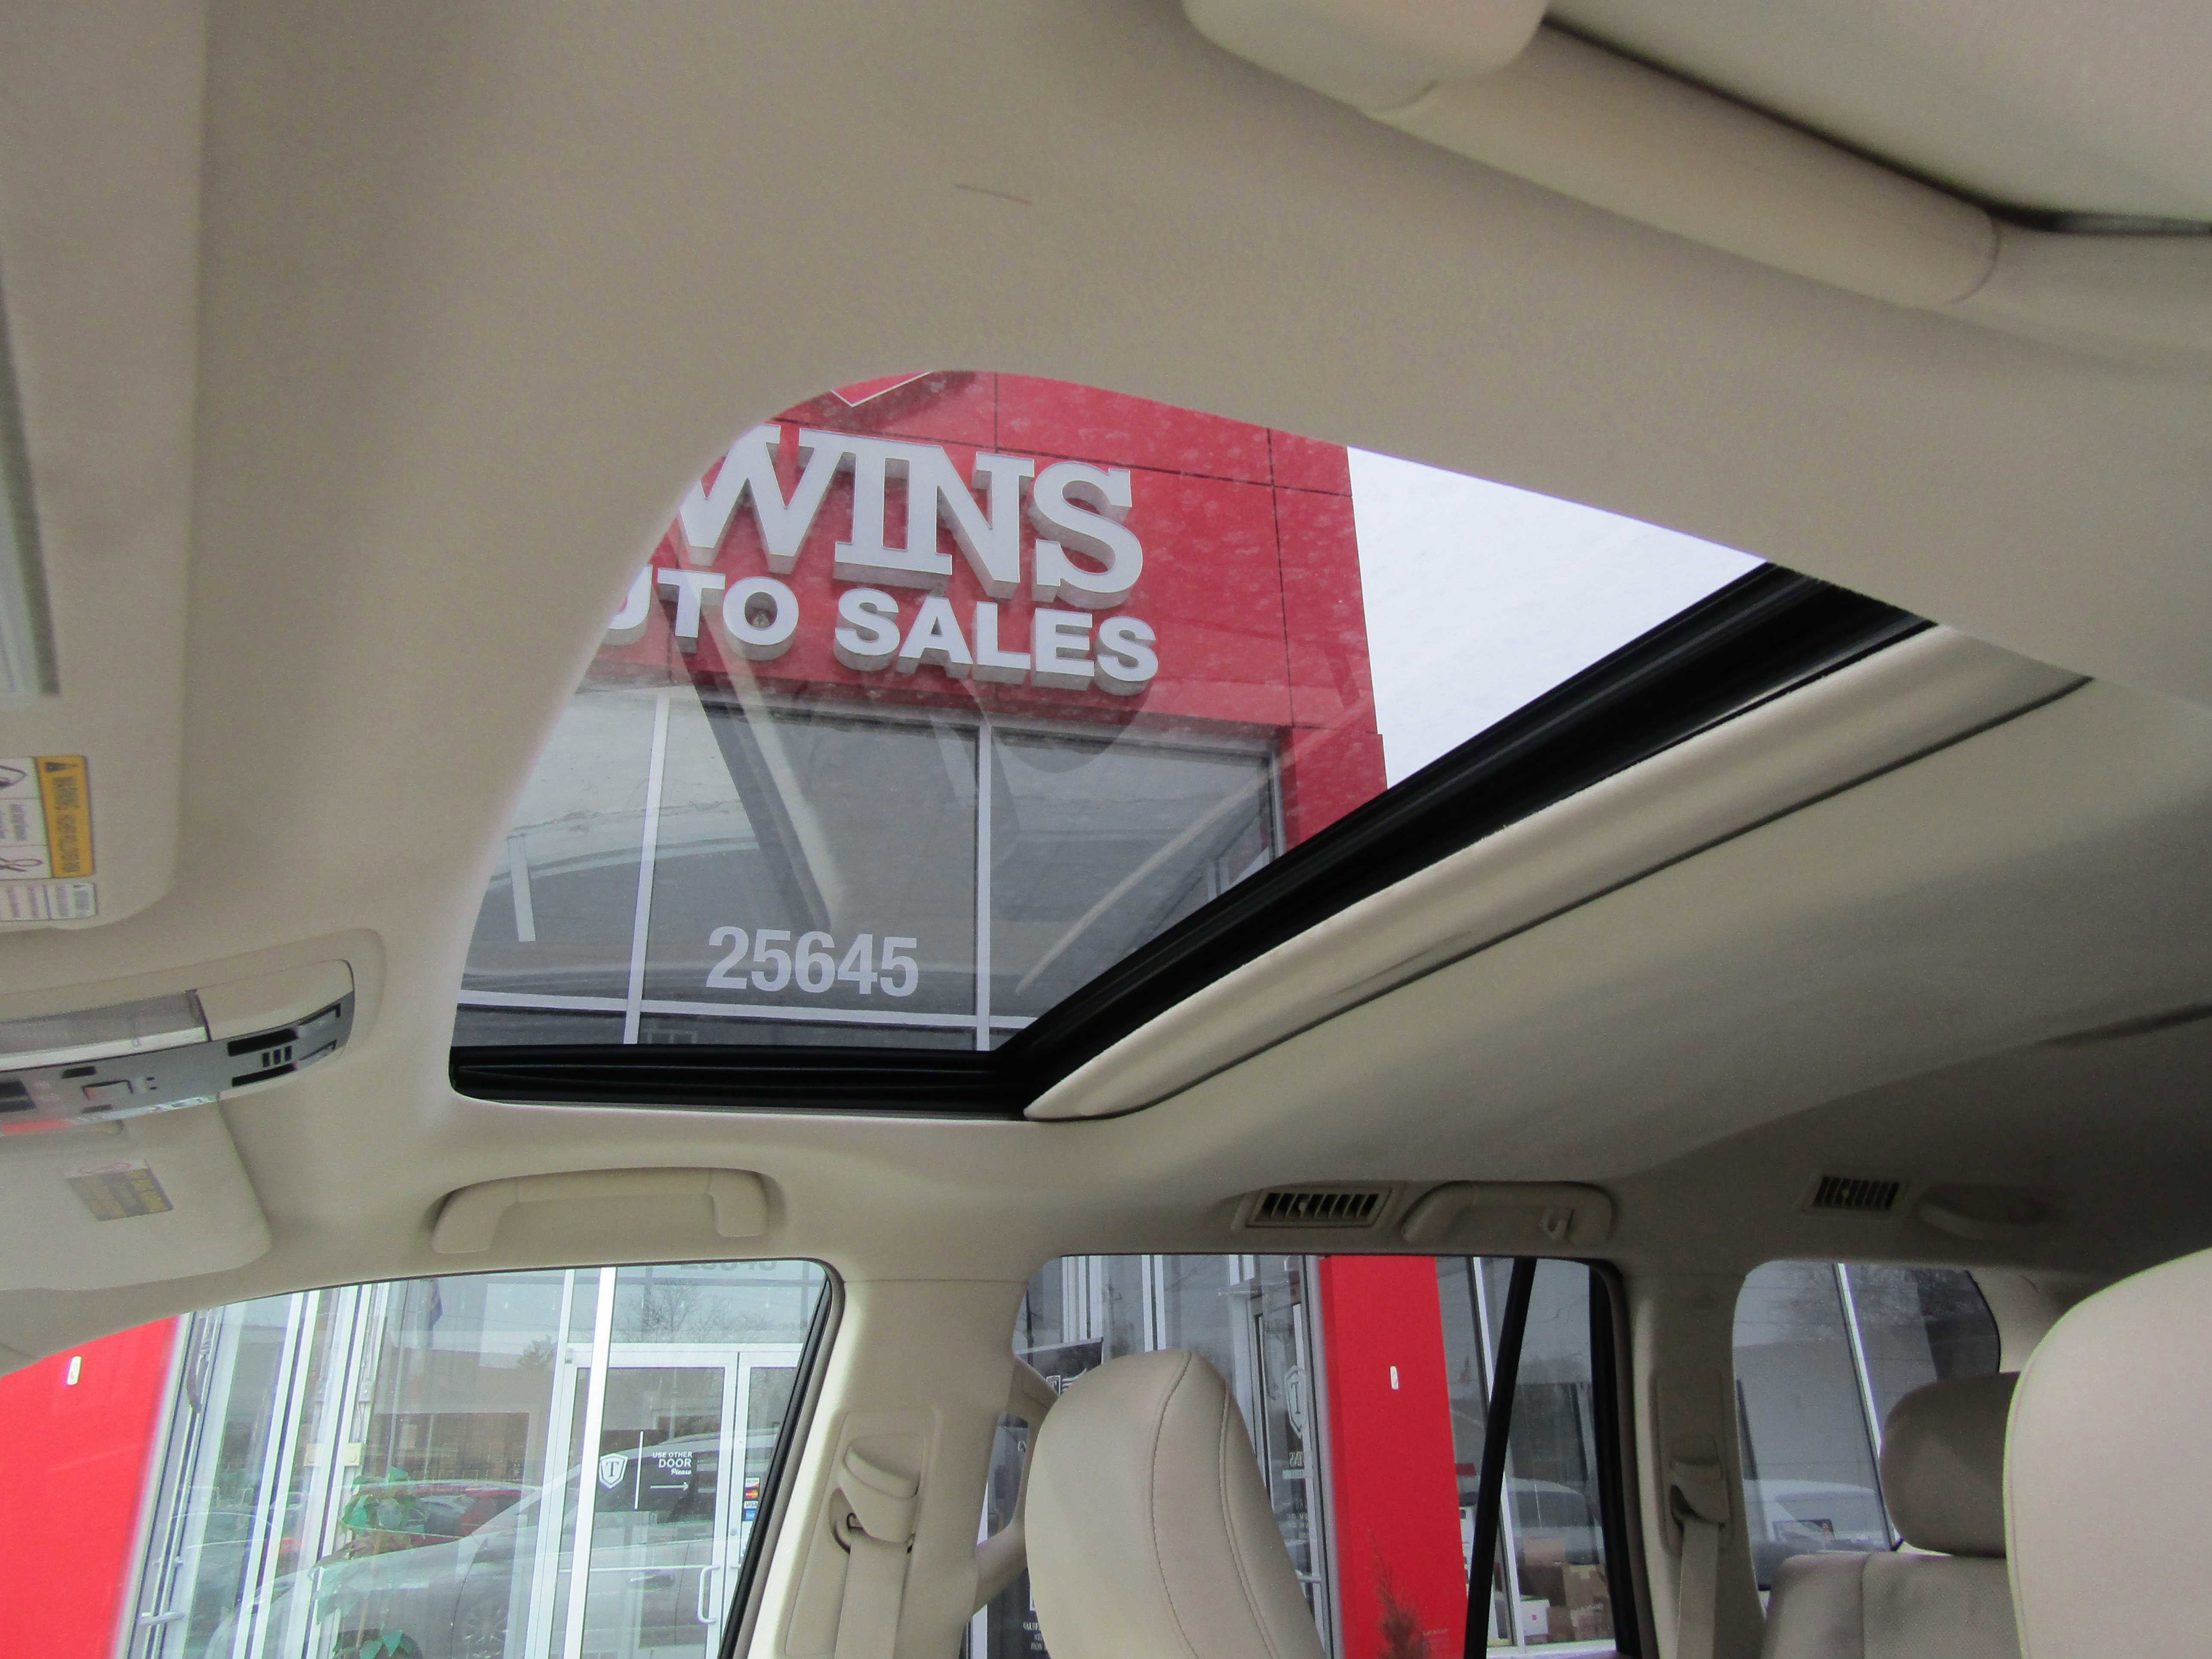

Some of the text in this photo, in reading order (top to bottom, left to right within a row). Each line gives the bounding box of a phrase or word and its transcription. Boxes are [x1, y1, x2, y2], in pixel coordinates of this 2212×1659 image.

[834, 588, 1158, 695] SALES
[705, 926, 919, 997] 25645
[659, 1458, 692, 1468] DOOR
